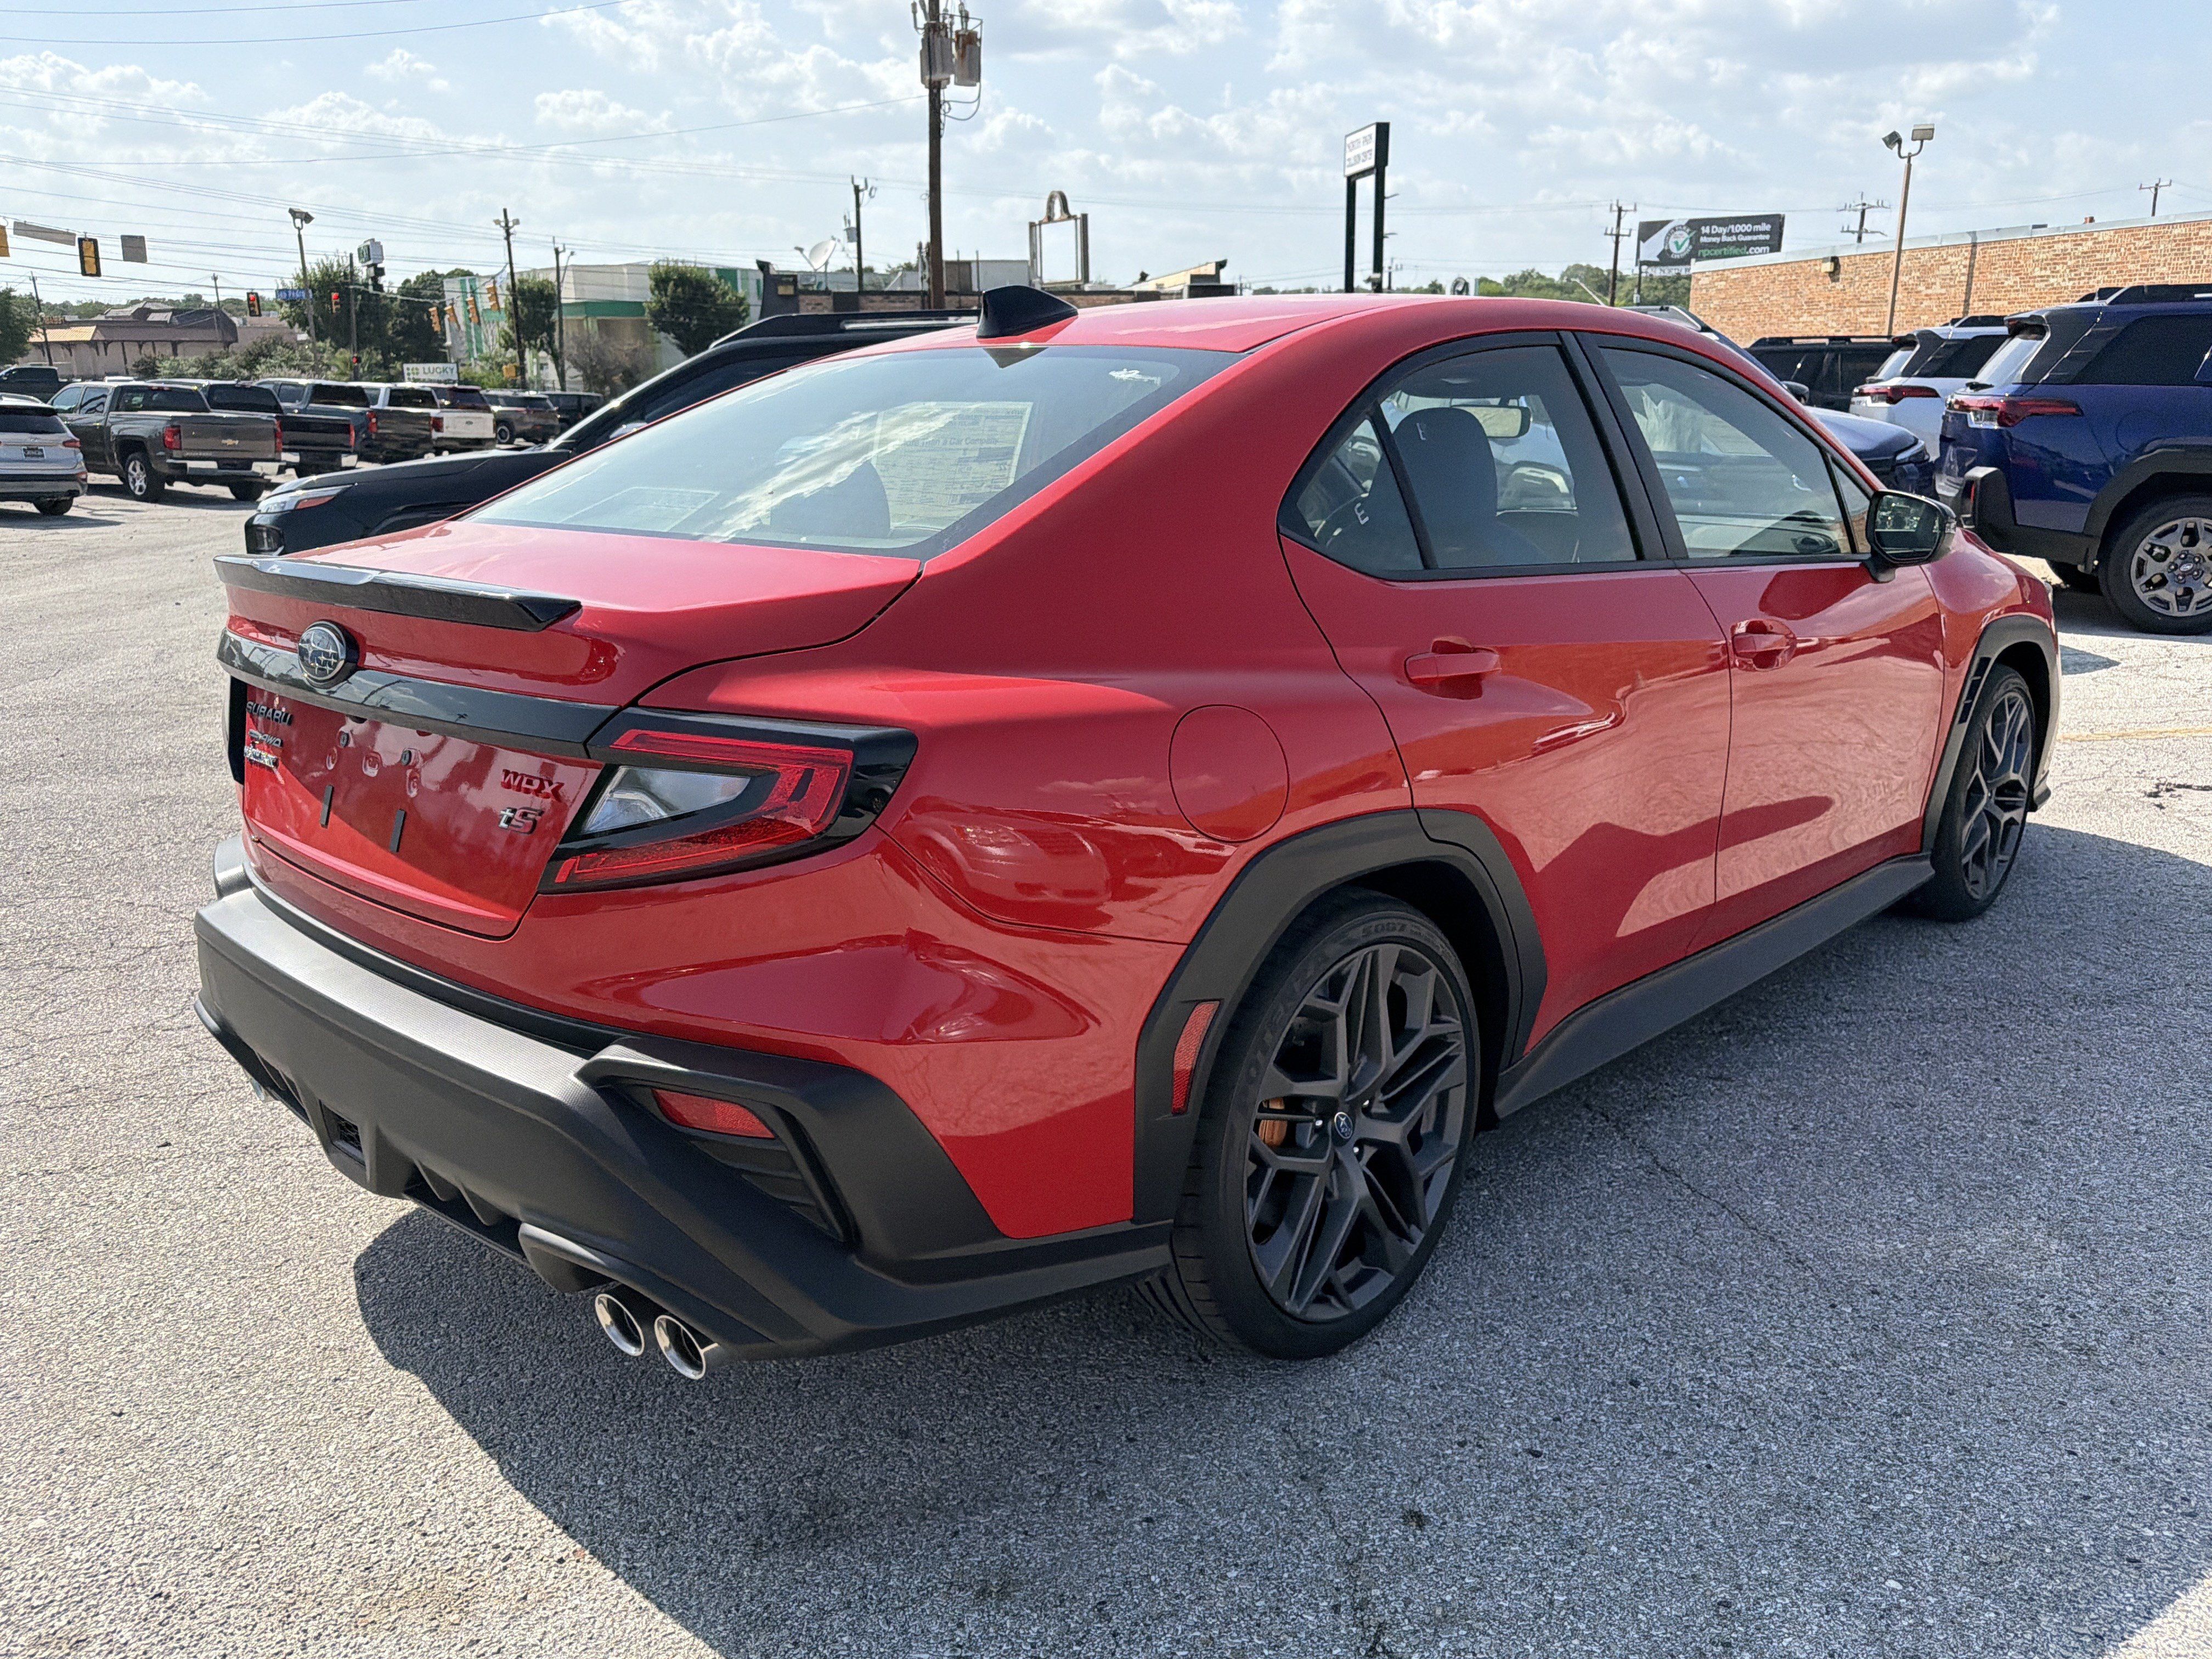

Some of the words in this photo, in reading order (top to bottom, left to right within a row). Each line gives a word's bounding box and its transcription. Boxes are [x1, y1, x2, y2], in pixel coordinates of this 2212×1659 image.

[1753, 222, 1771, 232] mile
[422, 366, 455, 375] LUCKY
[246, 701, 293, 726] SUBARU
[262, 733, 283, 748] AWD
[501, 769, 565, 802] WRX
